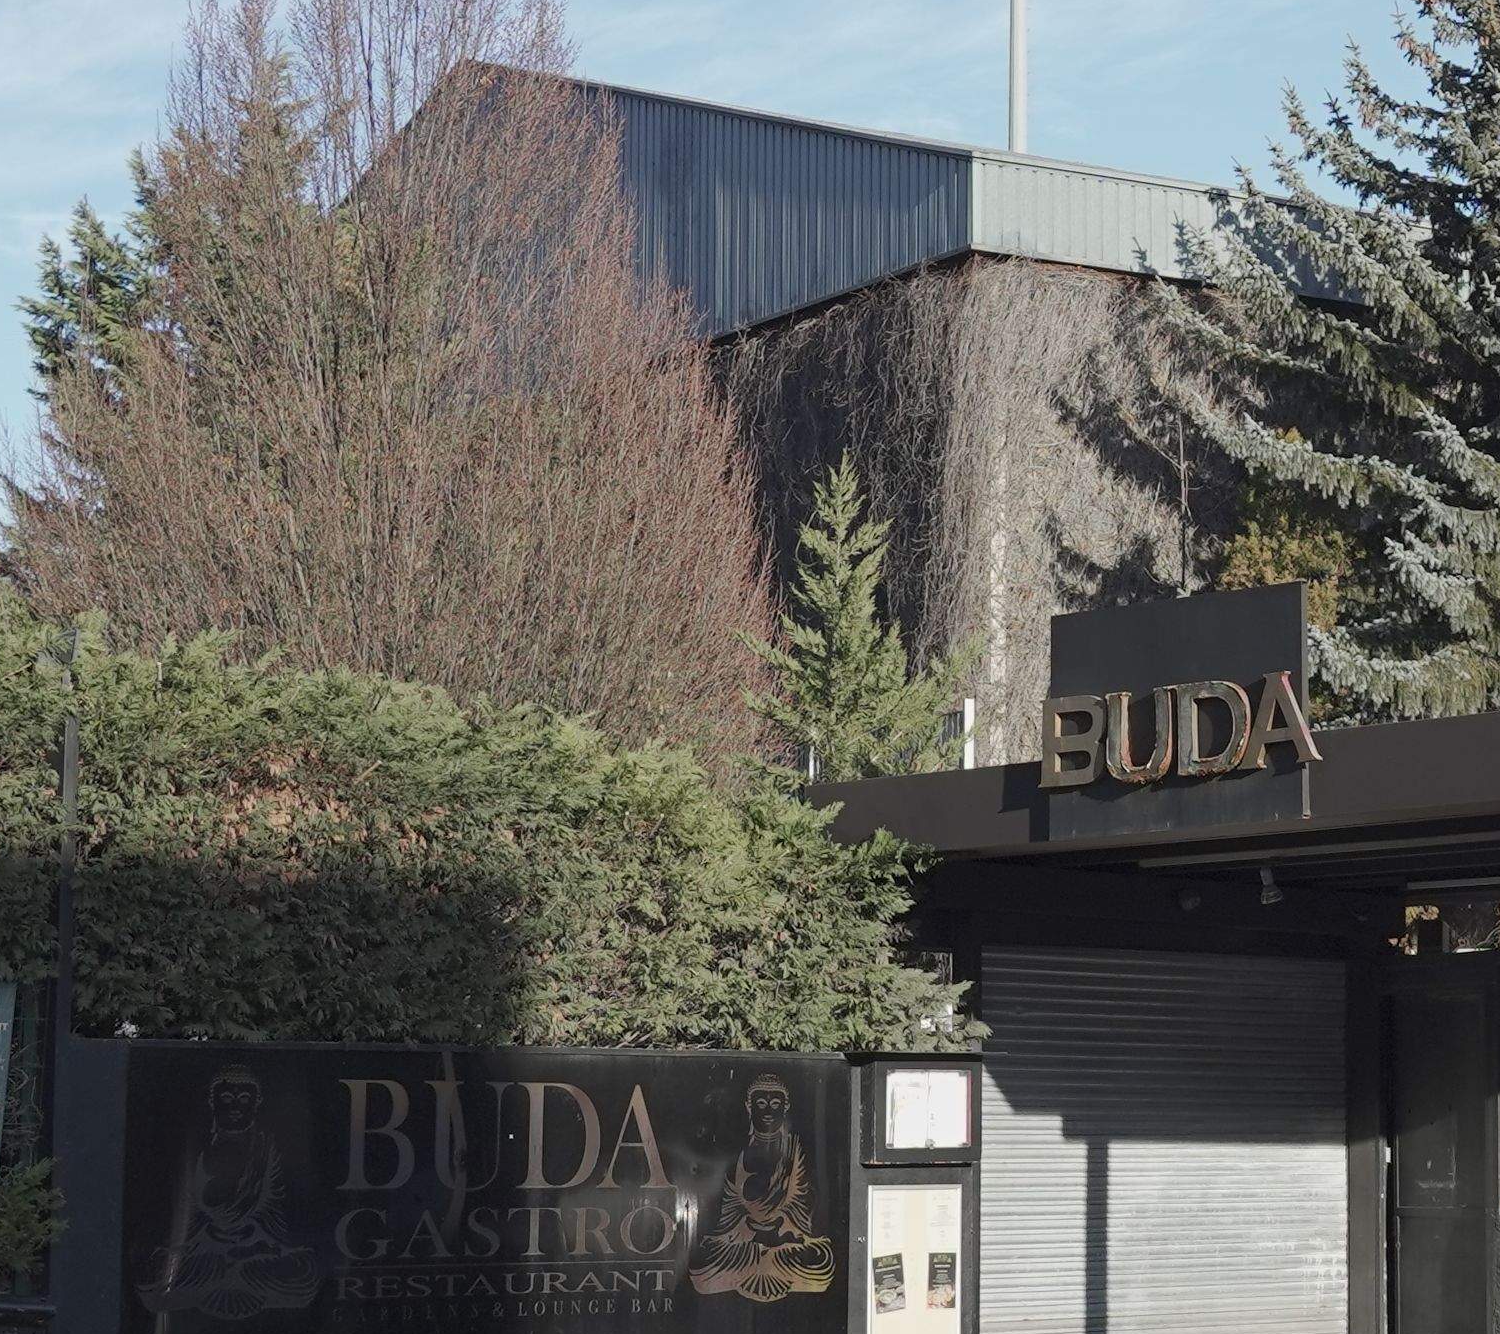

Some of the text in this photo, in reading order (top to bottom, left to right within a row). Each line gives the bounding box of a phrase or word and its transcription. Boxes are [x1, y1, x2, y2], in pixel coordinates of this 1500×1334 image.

[1038, 669, 1323, 789] BUDA
[336, 1079, 678, 1193] BUDA
[336, 1207, 677, 1261] GASTRO
[333, 1297, 676, 1322] GARDENS & LOUNGE BAR
[338, 1269, 676, 1301] RESTAURANT
